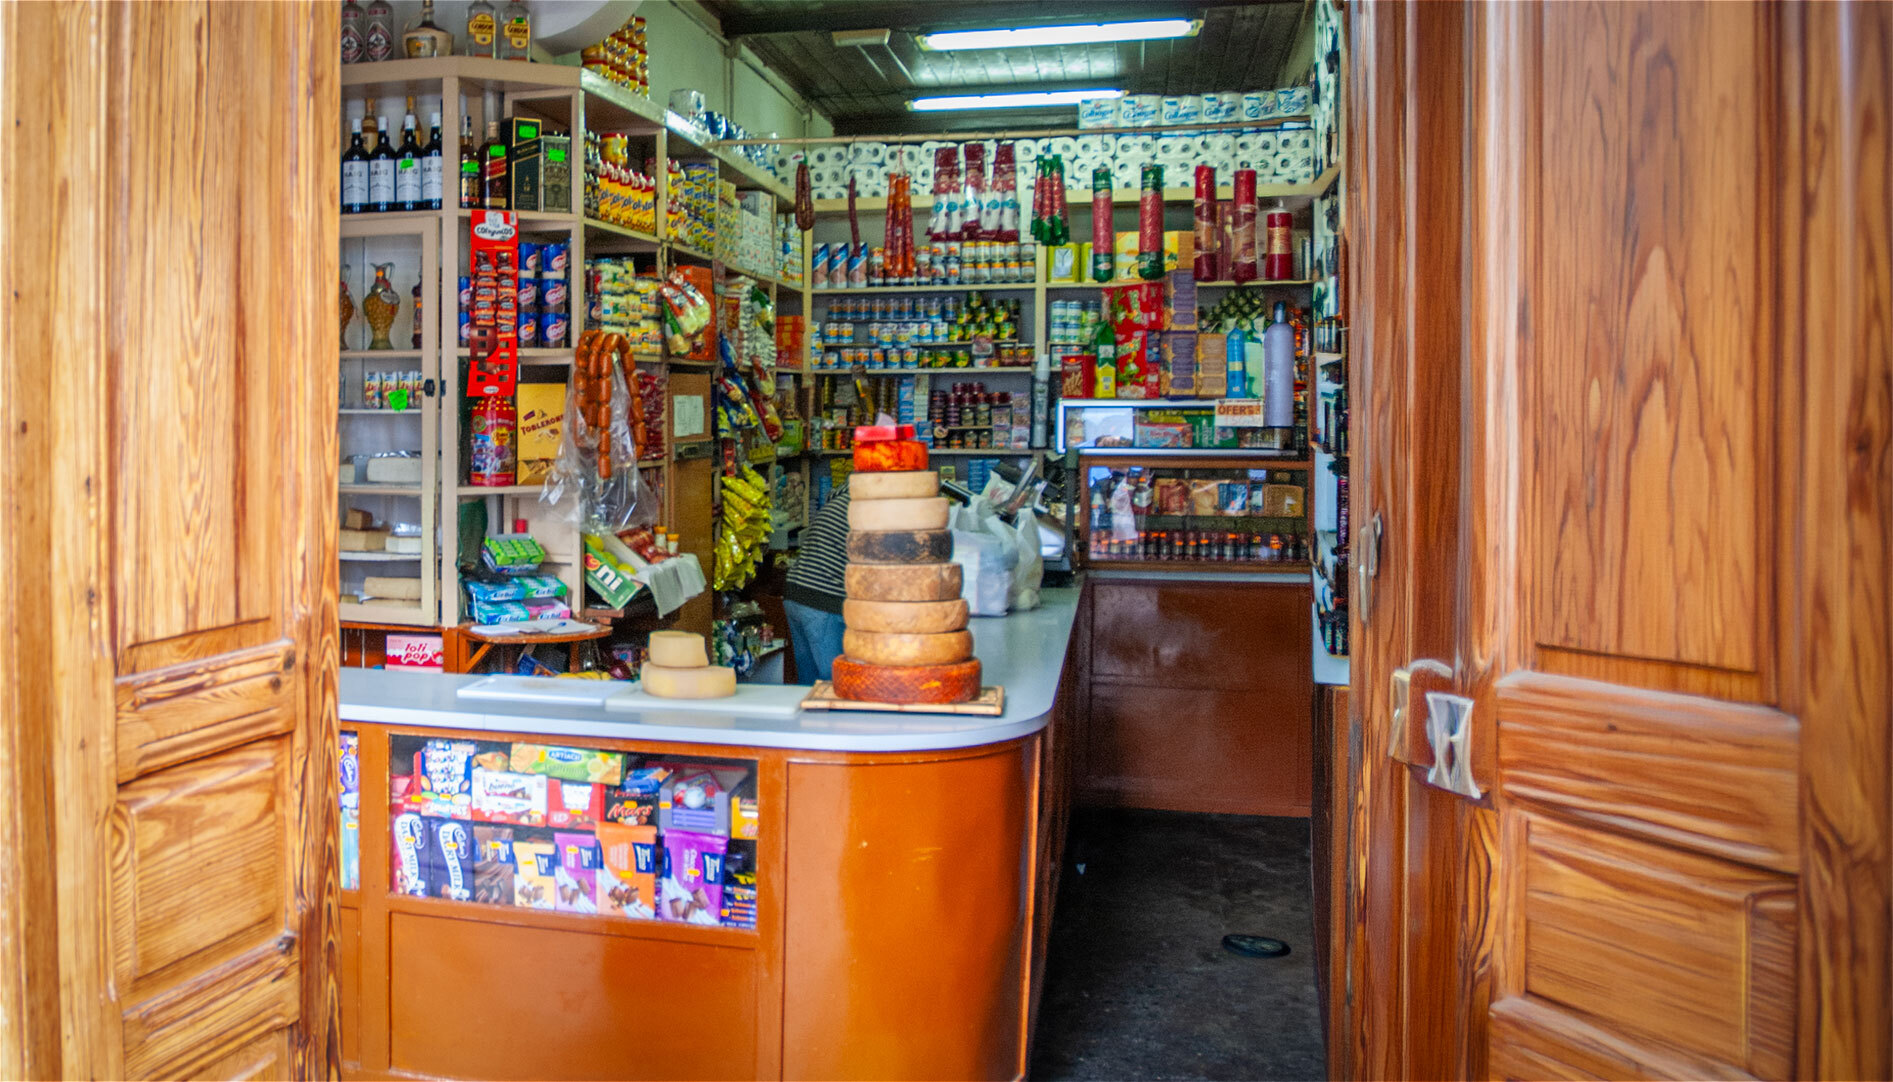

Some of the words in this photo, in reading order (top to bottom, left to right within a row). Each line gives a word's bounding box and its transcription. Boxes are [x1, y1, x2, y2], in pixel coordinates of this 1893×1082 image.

[405, 643, 428, 652] loli
[403, 652, 428, 662] pop
[607, 802, 654, 819] Mars
